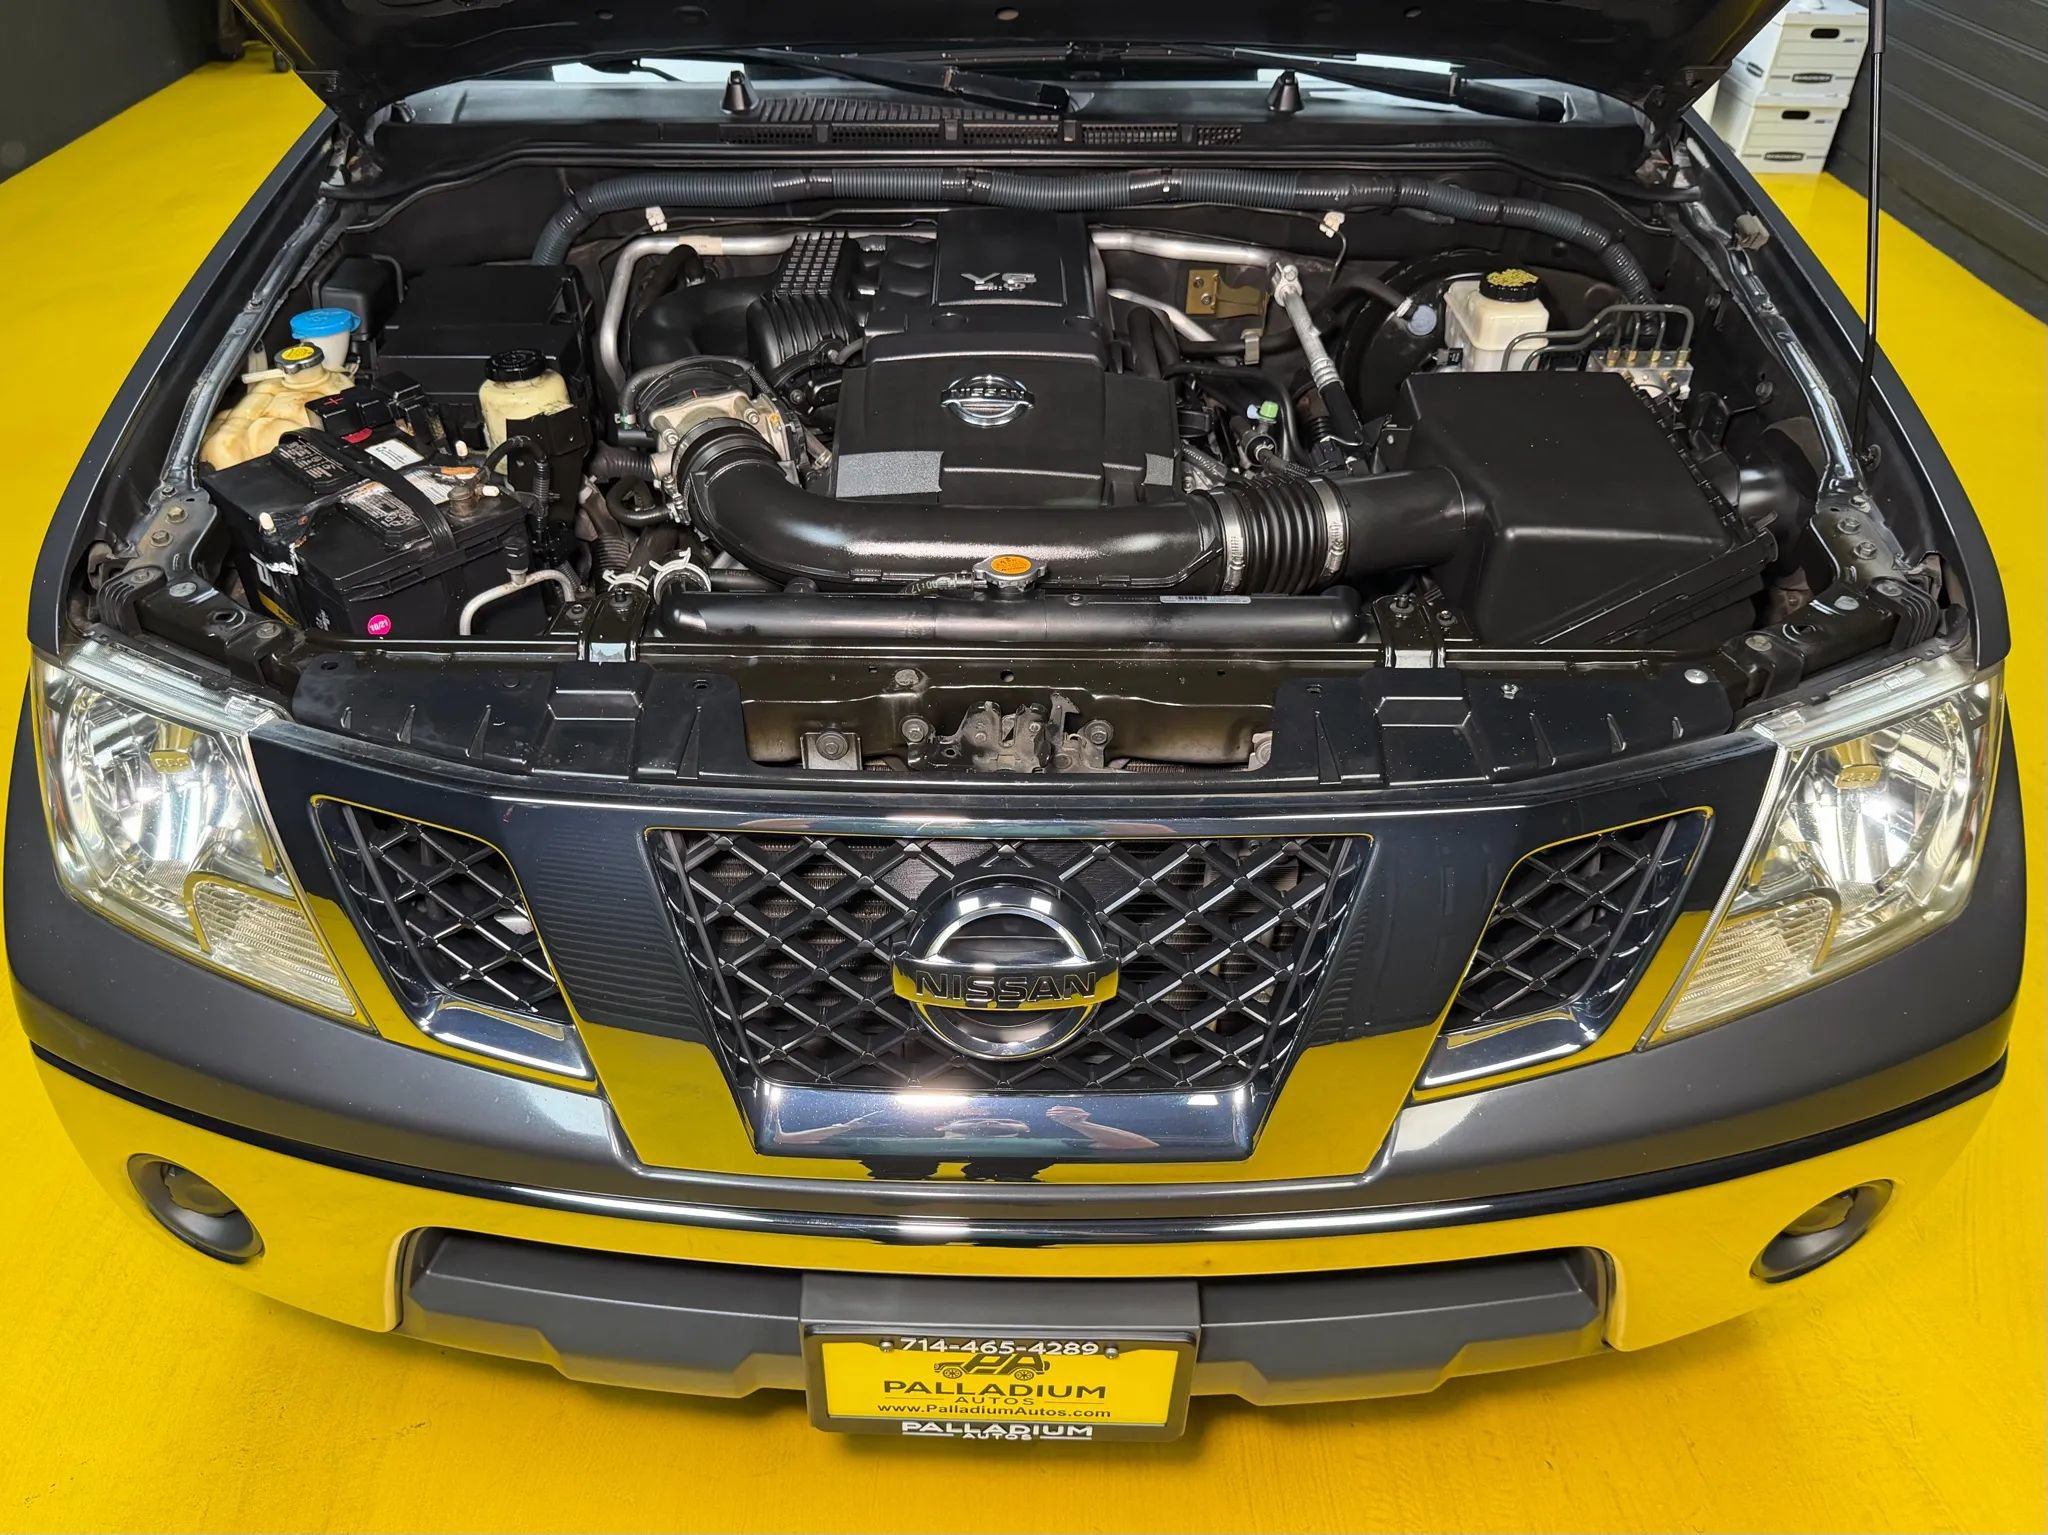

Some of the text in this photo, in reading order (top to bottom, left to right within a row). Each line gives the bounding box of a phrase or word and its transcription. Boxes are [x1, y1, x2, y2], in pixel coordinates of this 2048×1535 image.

[950, 387, 1024, 399] NISSAN
[915, 970, 1096, 1003] NISSAN
[901, 1337, 1099, 1355] 714-465-4289
[884, 1380, 1106, 1399] PALLADIUM
[955, 1396, 1034, 1405] AUTOS
[878, 1403, 1111, 1418] www.PalladiumAutos.com
[902, 1421, 1093, 1437] PALLADIUM
[962, 1433, 1033, 1441] AUTOS
